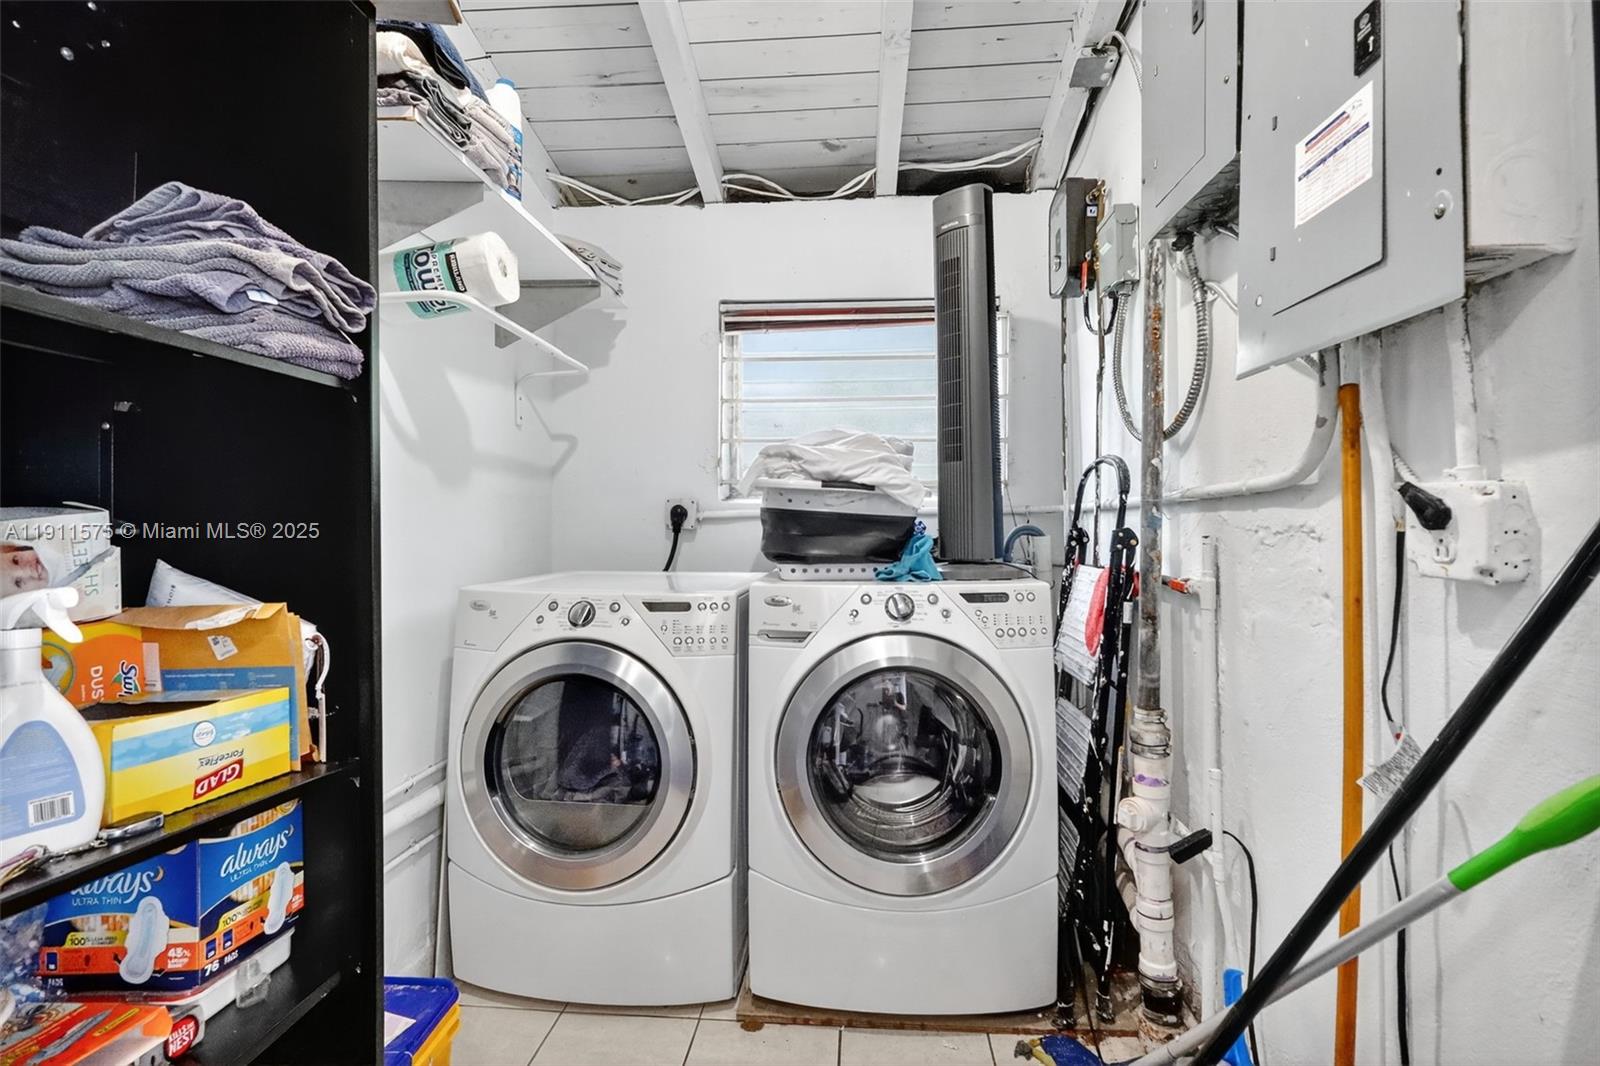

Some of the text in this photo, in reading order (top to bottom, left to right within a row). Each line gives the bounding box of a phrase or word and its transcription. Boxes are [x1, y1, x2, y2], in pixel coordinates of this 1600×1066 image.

[431, 251, 445, 291] PREMI
[91, 665, 104, 700] DUS
[199, 749, 244, 768] ForceFlex
[196, 764, 240, 795] GLAD
[220, 830, 289, 878] always
[71, 869, 154, 903] ways
[71, 897, 123, 907] ULTRA THIN
[204, 960, 220, 977] 76
[168, 1027, 194, 1058] NEST
